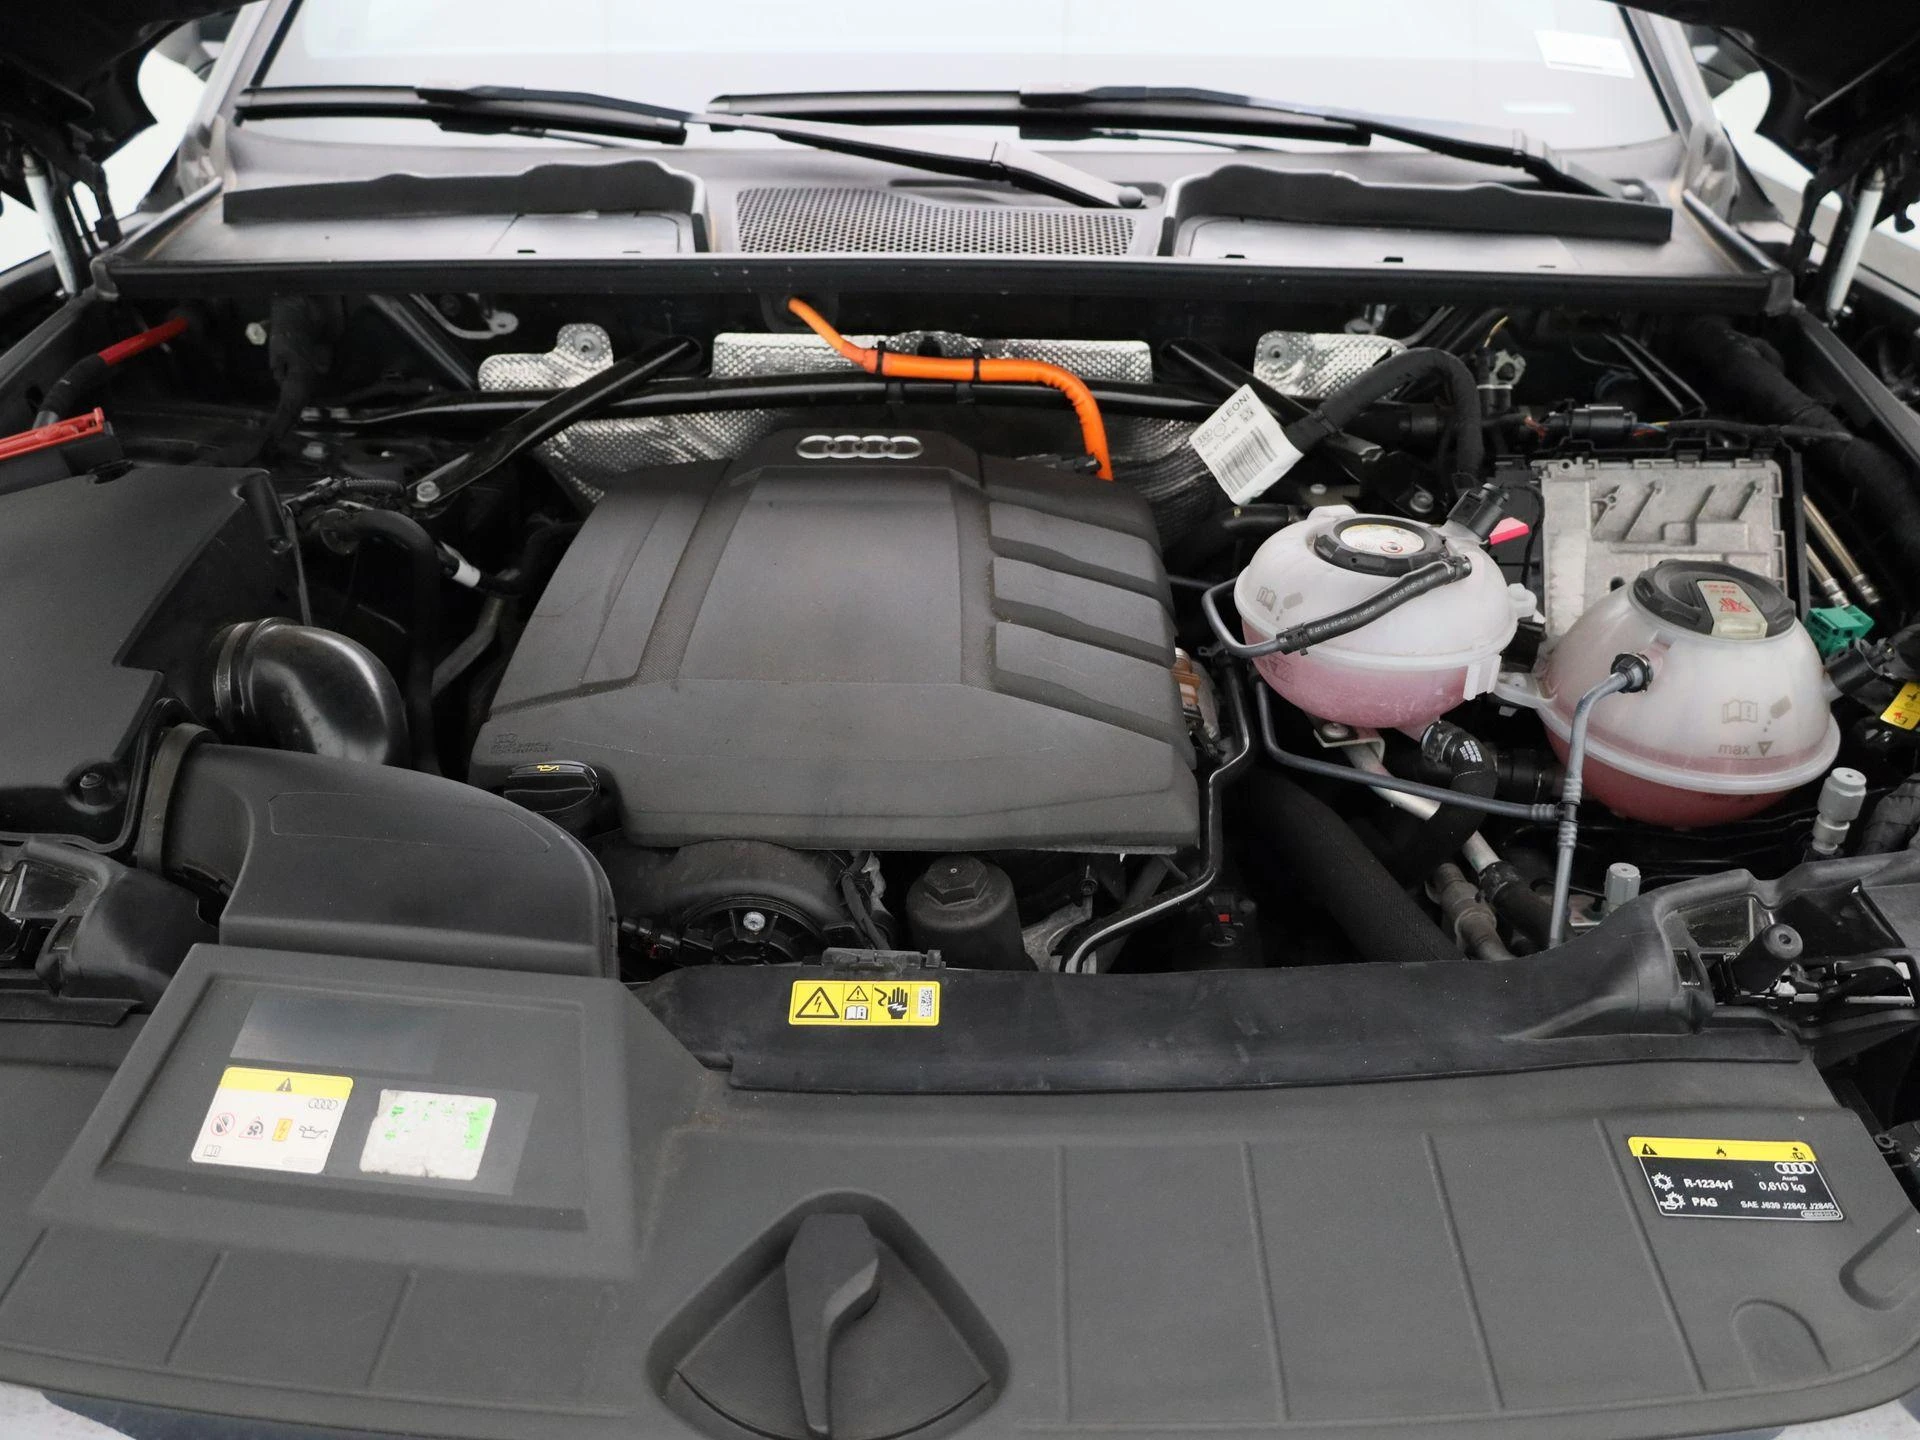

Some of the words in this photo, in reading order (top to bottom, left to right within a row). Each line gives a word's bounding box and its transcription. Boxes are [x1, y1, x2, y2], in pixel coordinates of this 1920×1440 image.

[1220, 393, 1250, 422] LEONI
[1718, 744, 1750, 756] max
[1683, 1178, 1734, 1191] R-1234yf
[1758, 1181, 1790, 1192] 0,610
[1790, 1182, 1807, 1194] kg
[1691, 1197, 1719, 1207] PAG
[1740, 1200, 1760, 1209] SAE
